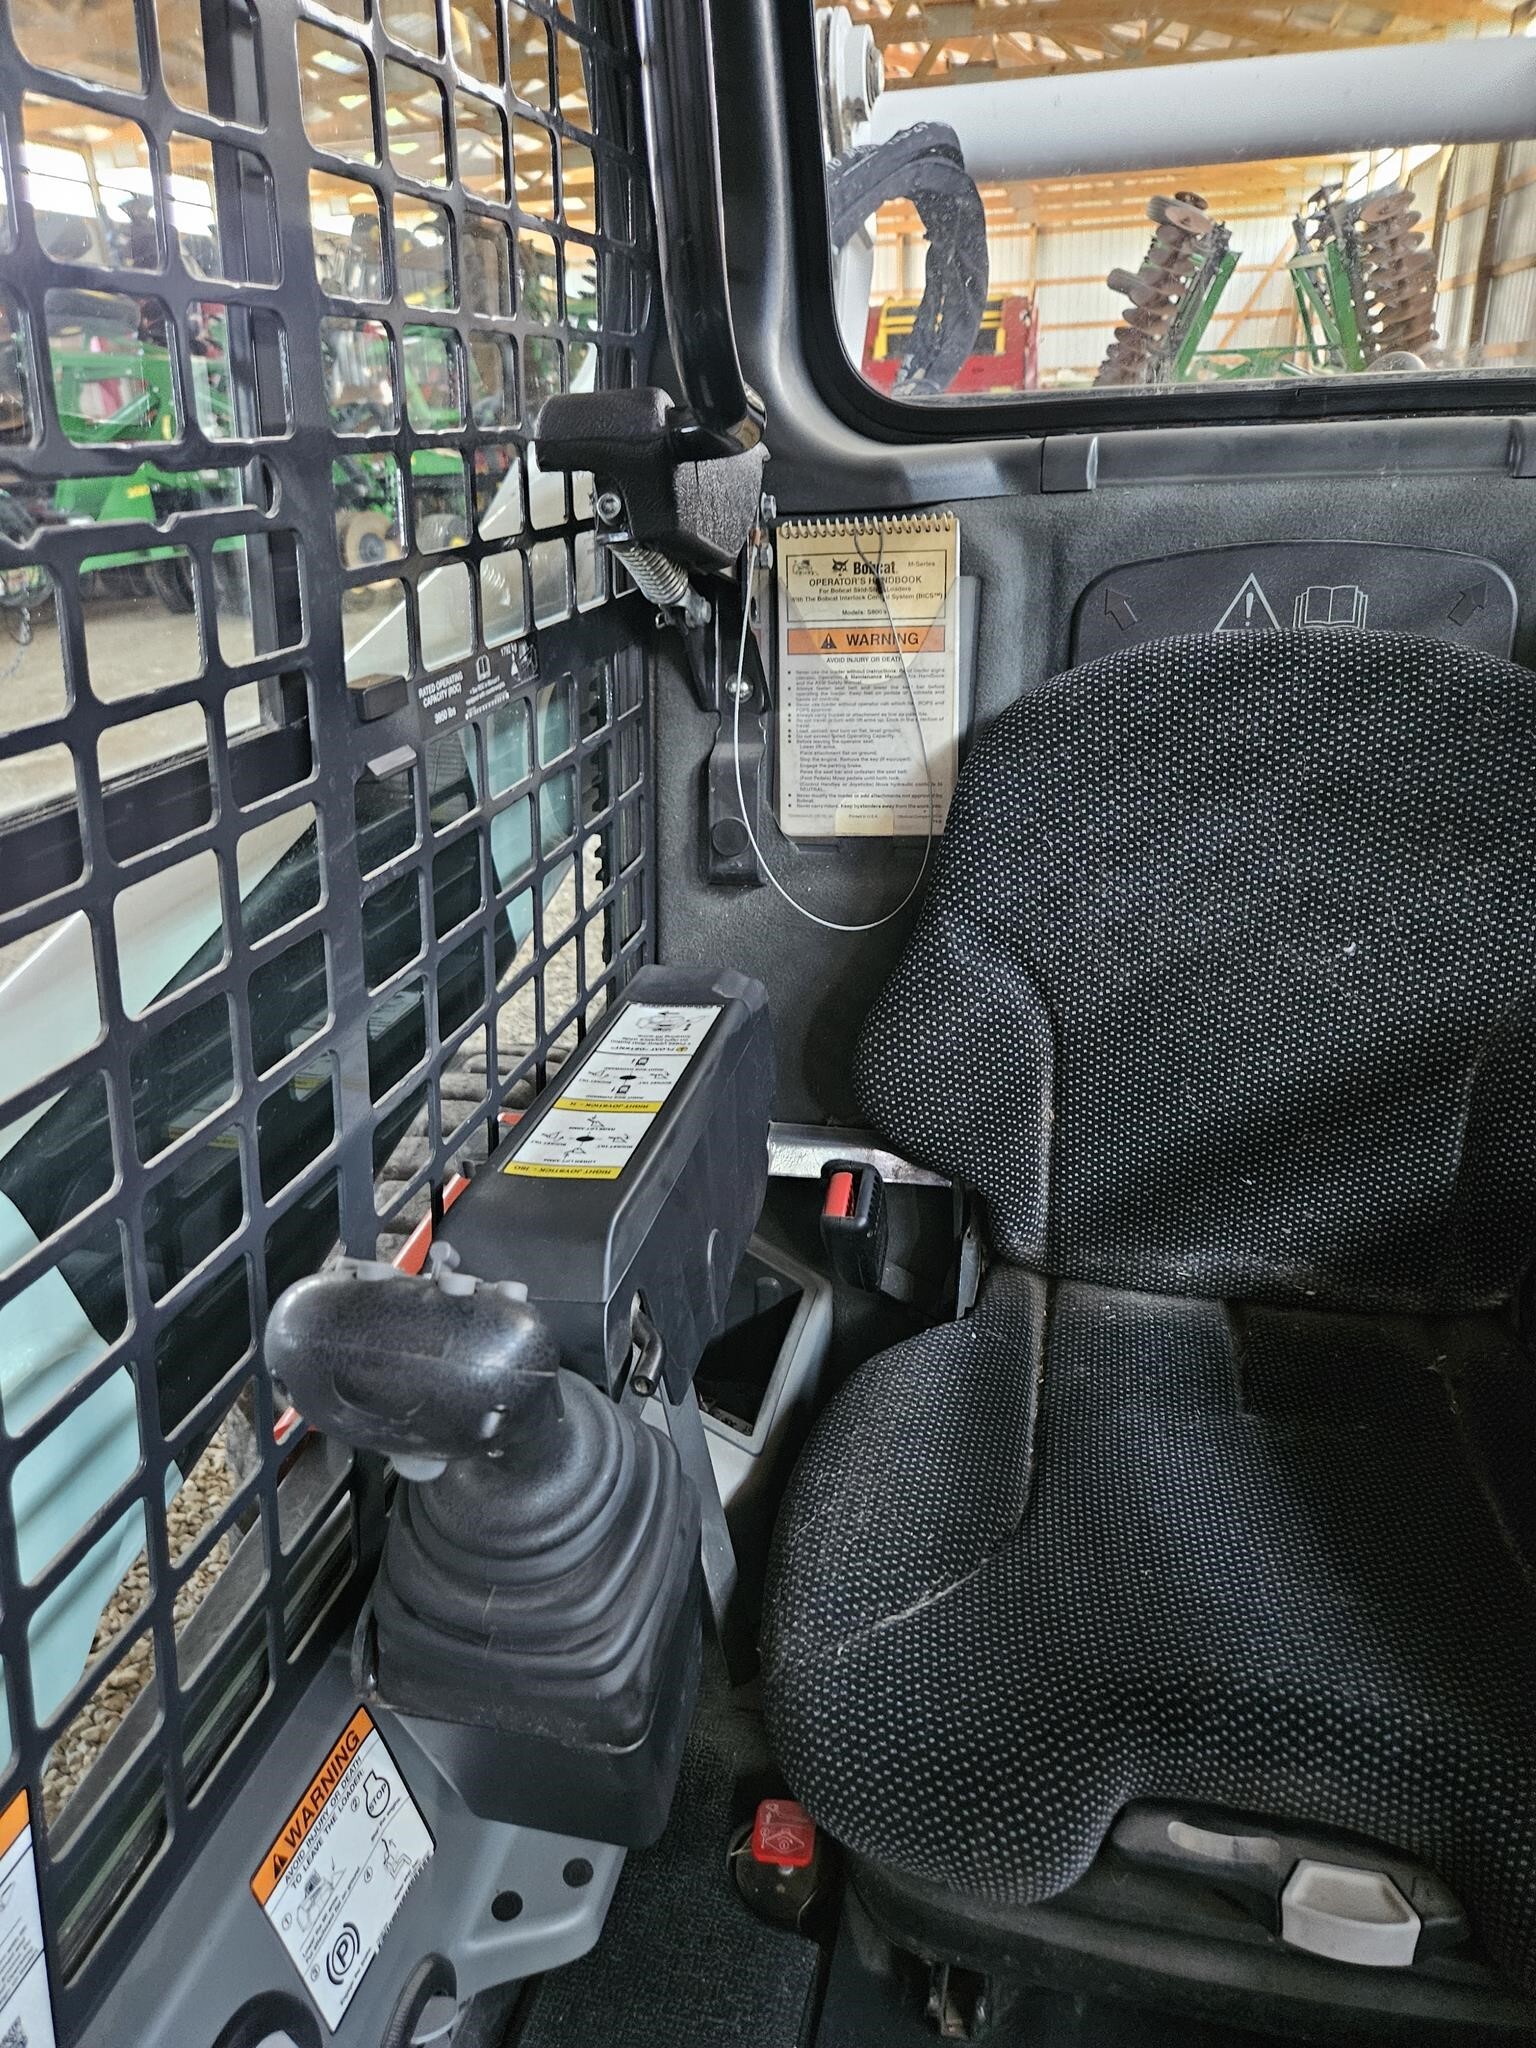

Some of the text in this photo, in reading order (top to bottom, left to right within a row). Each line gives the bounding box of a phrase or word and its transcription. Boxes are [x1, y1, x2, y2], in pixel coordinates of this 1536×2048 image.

[809, 577, 866, 586] OPERATOR'S
[846, 633, 918, 646] WARNING
[418, 684, 436, 699] RATED
[436, 670, 464, 690] OPERATING
[423, 688, 448, 708] CAPACITY
[284, 1729, 360, 1849] WARNING
[369, 1782, 388, 1812] STOP
[283, 1753, 361, 1885] AVOID INJURY OR DEATH
[291, 1766, 365, 1890] TO LEAVE THE LOADER:
[336, 1937, 352, 1966] P
